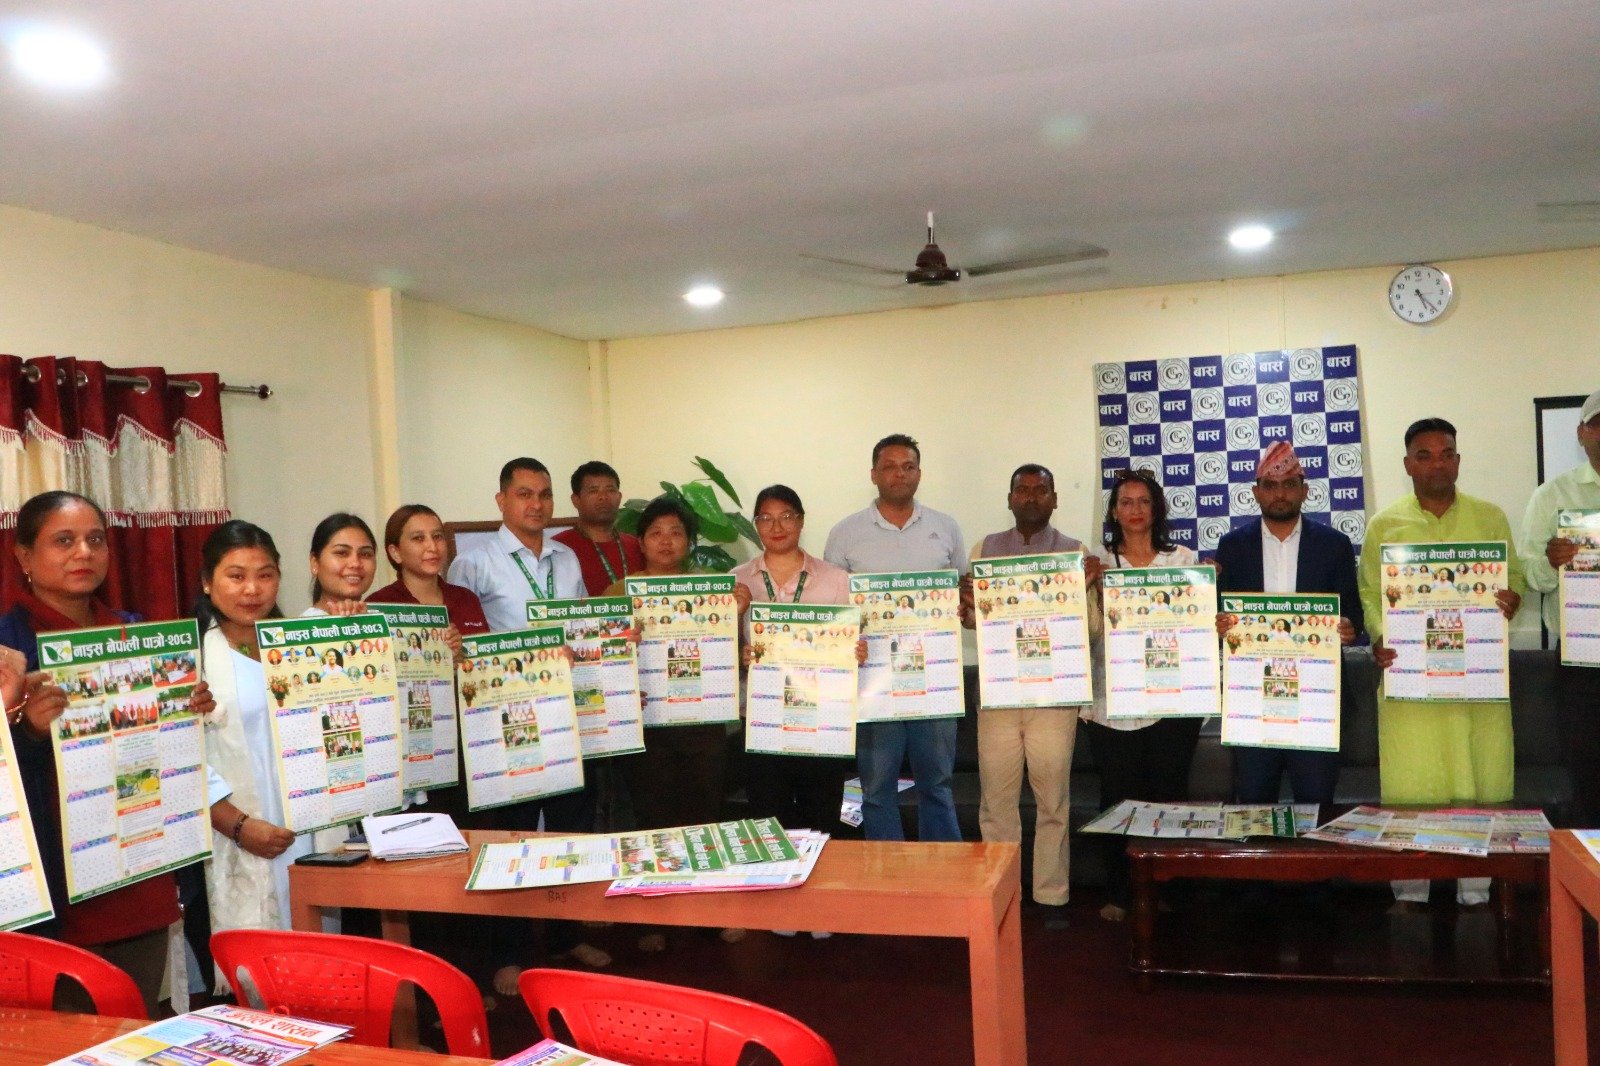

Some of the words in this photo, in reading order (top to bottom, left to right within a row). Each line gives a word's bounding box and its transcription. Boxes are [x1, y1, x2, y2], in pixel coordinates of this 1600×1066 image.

[1260, 360, 1283, 372] बास
[1326, 356, 1351, 367] बास
[1129, 370, 1152, 382] बास
[1193, 366, 1217, 377] बास
[1228, 395, 1252, 406] बास
[1294, 391, 1319, 402] बास
[1100, 404, 1122, 416] बास
[1163, 400, 1186, 412] बास
[1263, 426, 1287, 437] बास
[1330, 422, 1354, 433] बास
[1133, 434, 1156, 445] बास
[1197, 430, 1220, 441] बास
[1166, 464, 1190, 475] बास
[1231, 460, 1255, 472] बास
[1334, 488, 1358, 499] बास
[1200, 495, 1223, 506] बास
[892, 578, 914, 588] नेपाली
[570, 604, 591, 616] नेपाली
[1267, 601, 1291, 611] नेपाली
[285, 630, 309, 642] नाइस
[313, 625, 340, 638] नेपाली
[73, 643, 103, 659] नाइस
[107, 637, 139, 653] नेपाली
[500, 637, 522, 650] नेपाली
